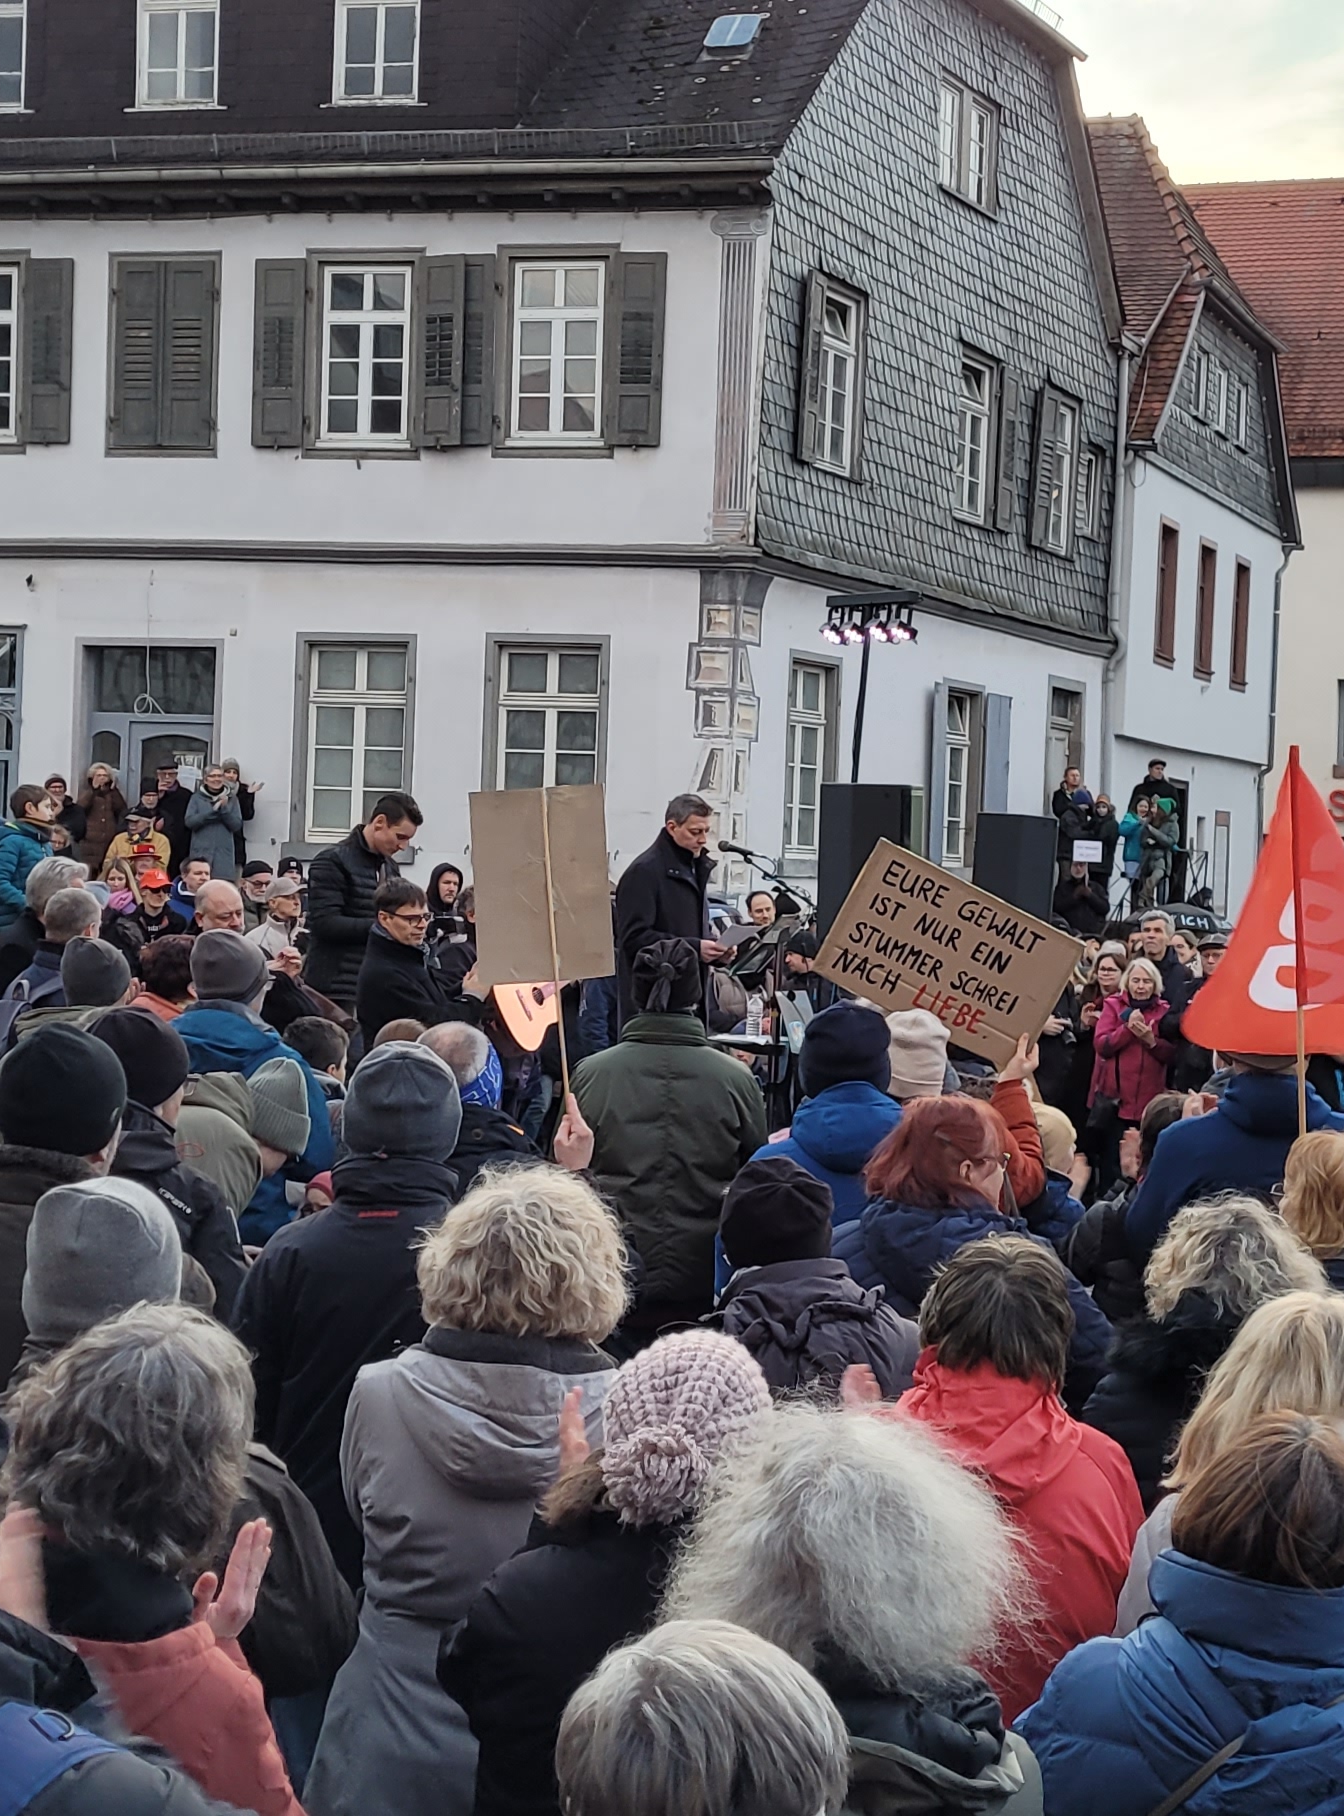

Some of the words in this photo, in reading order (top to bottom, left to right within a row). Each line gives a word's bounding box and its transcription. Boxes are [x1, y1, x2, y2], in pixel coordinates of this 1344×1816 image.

[869, 892, 907, 921] IST
[913, 912, 962, 952] NUR
[970, 941, 1013, 975] EIN
[881, 859, 950, 909] EURE
[957, 900, 1047, 954] GEWALT
[831, 948, 902, 995] NACH
[911, 983, 989, 1040] LIEBE.
[848, 921, 943, 983] STUMMER
[950, 970, 1019, 1016] SCHREI
